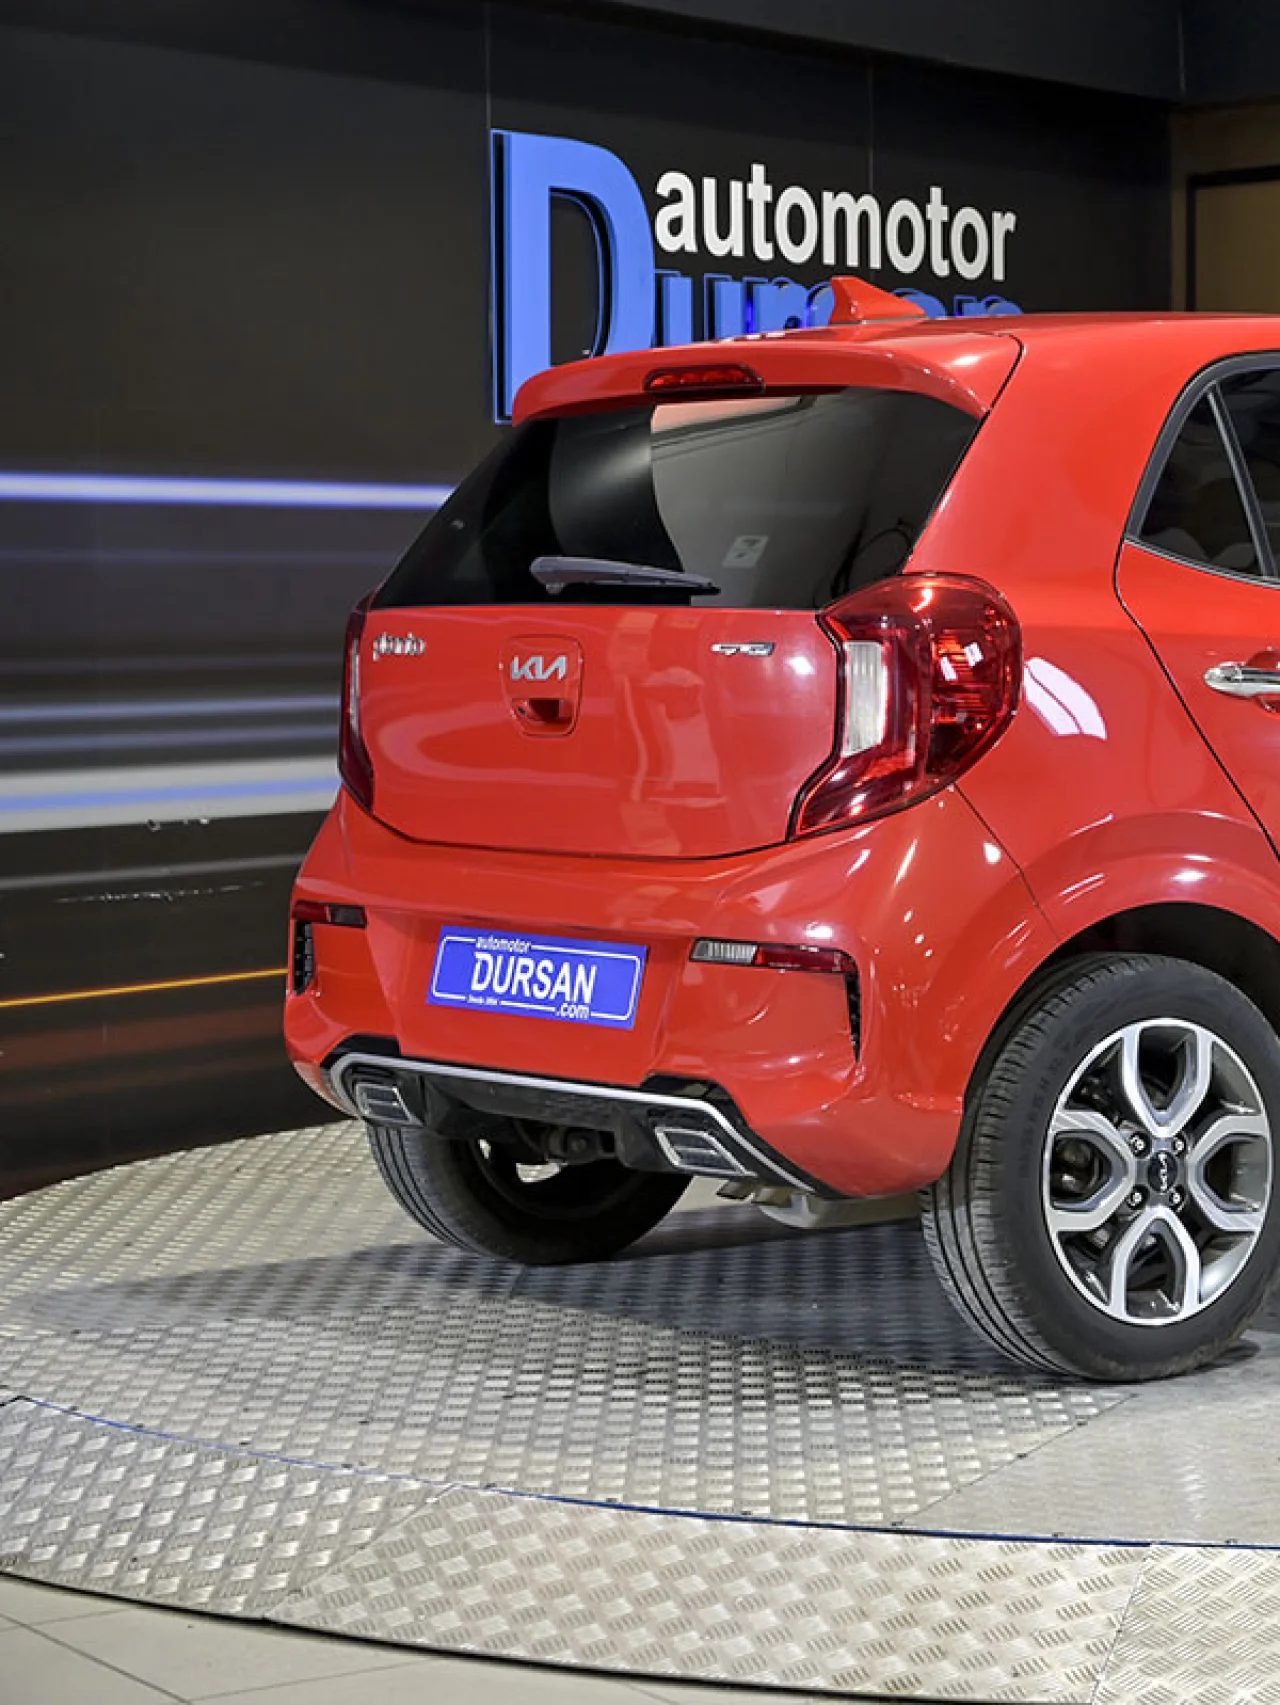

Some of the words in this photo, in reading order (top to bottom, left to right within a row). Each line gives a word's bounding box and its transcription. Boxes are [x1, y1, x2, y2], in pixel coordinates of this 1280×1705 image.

[654, 163, 1016, 281] automotor
[511, 655, 567, 680] KIA
[471, 951, 597, 1004] DURSAN
[556, 1002, 590, 1020] .com
